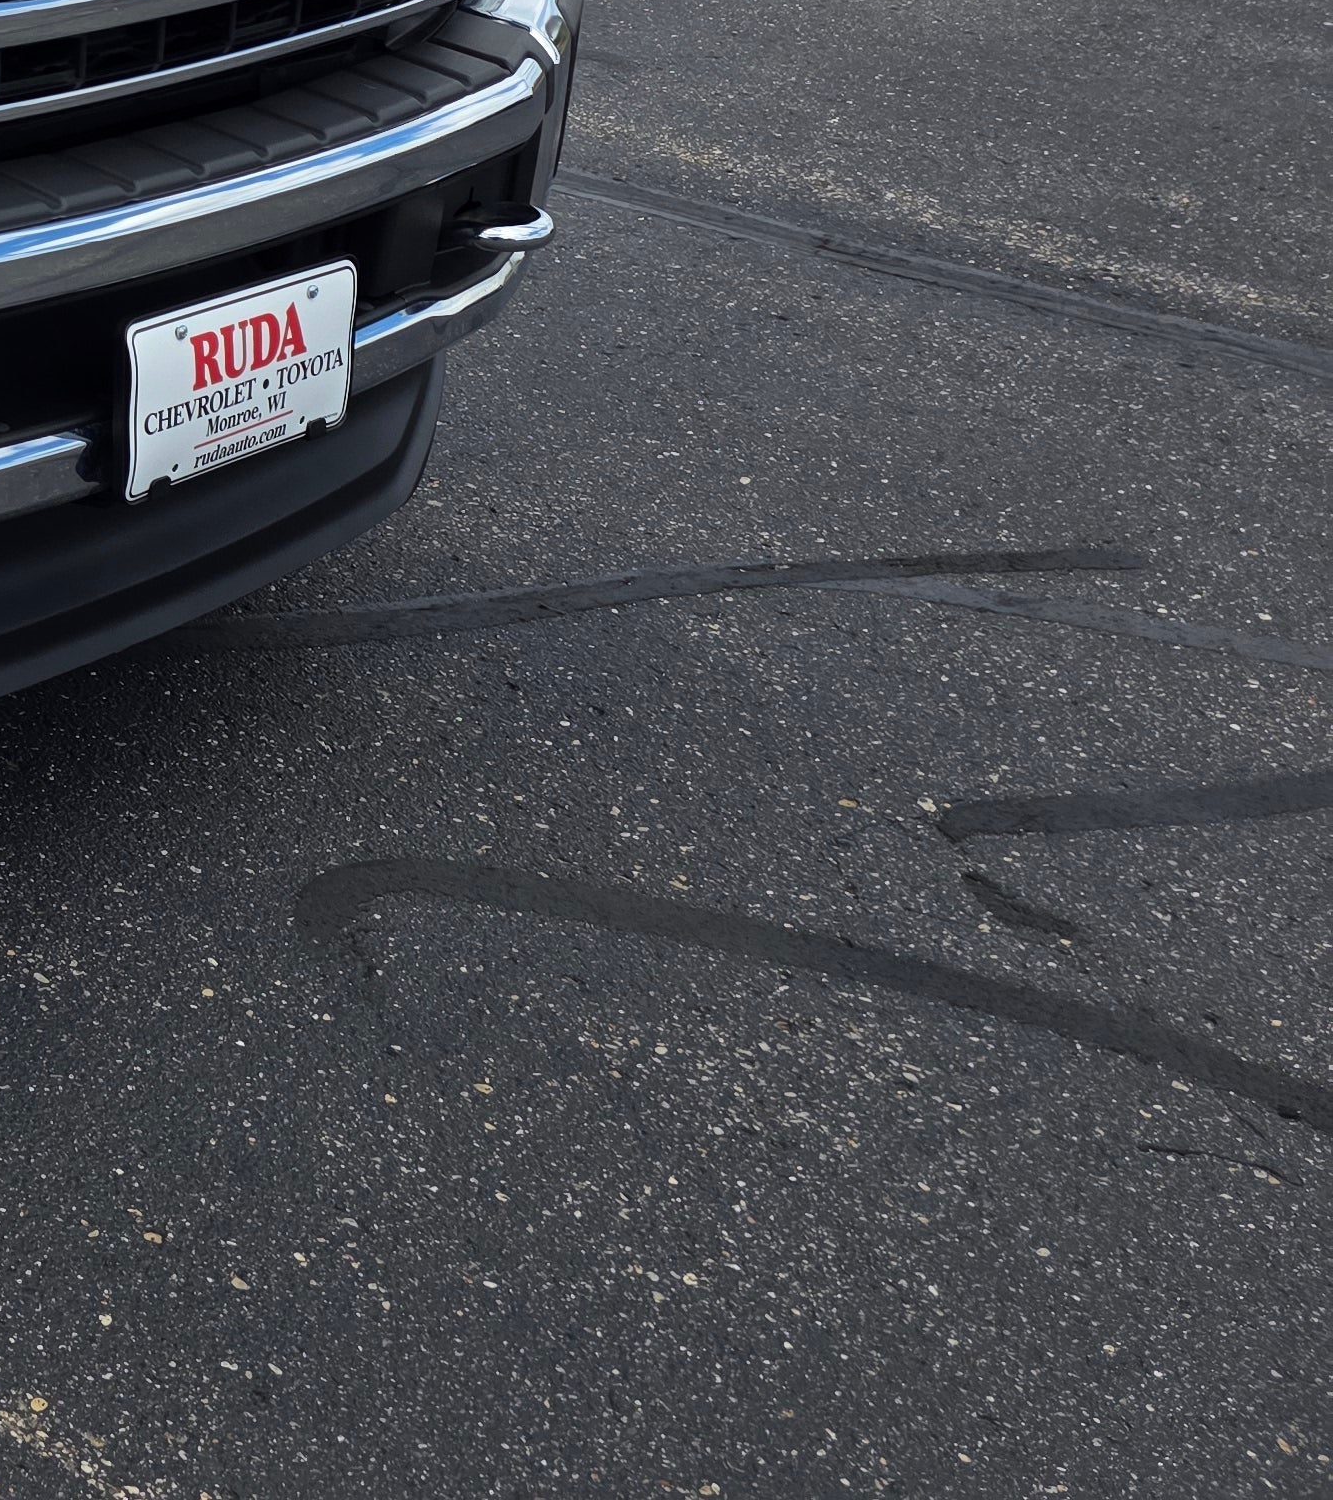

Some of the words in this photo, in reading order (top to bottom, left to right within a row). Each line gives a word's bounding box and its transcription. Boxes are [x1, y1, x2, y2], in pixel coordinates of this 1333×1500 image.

[190, 301, 308, 392] RUDA
[144, 377, 257, 436] CHEVROLET
[276, 347, 344, 390] TOYOTA
[206, 405, 262, 438] Monroe,
[267, 391, 287, 415] WI
[194, 423, 287, 469] rudaauto.com
